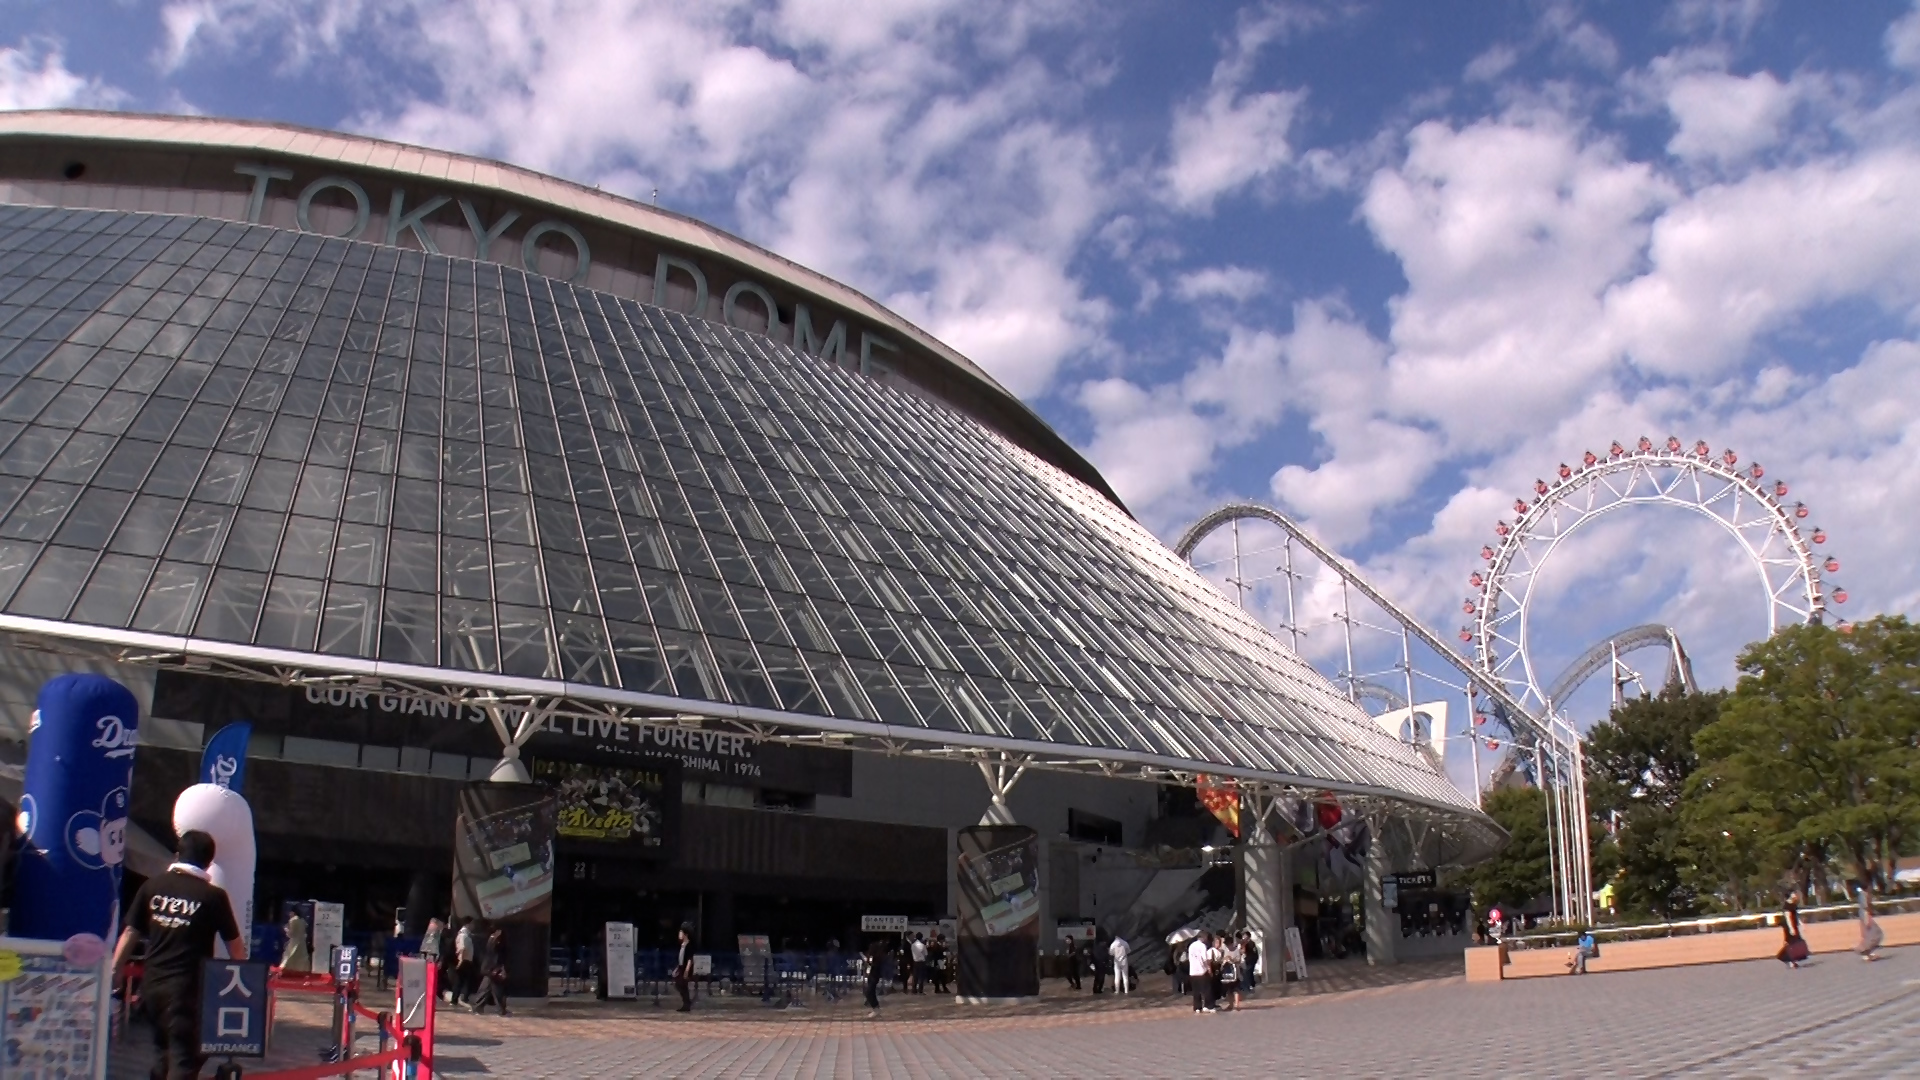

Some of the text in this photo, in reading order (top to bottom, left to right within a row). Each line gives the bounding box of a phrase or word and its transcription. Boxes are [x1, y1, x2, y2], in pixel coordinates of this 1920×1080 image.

[234, 163, 899, 377] TOKYO DOME
[378, 691, 486, 723] GIANTS
[572, 717, 630, 742] LIVE
[645, 749, 720, 772] SHIMA
[1398, 875, 1433, 884] TICKETS
[339, 949, 352, 974] 出口
[217, 964, 253, 1038] 入口
[200, 1043, 261, 1054] ENTRANCE
